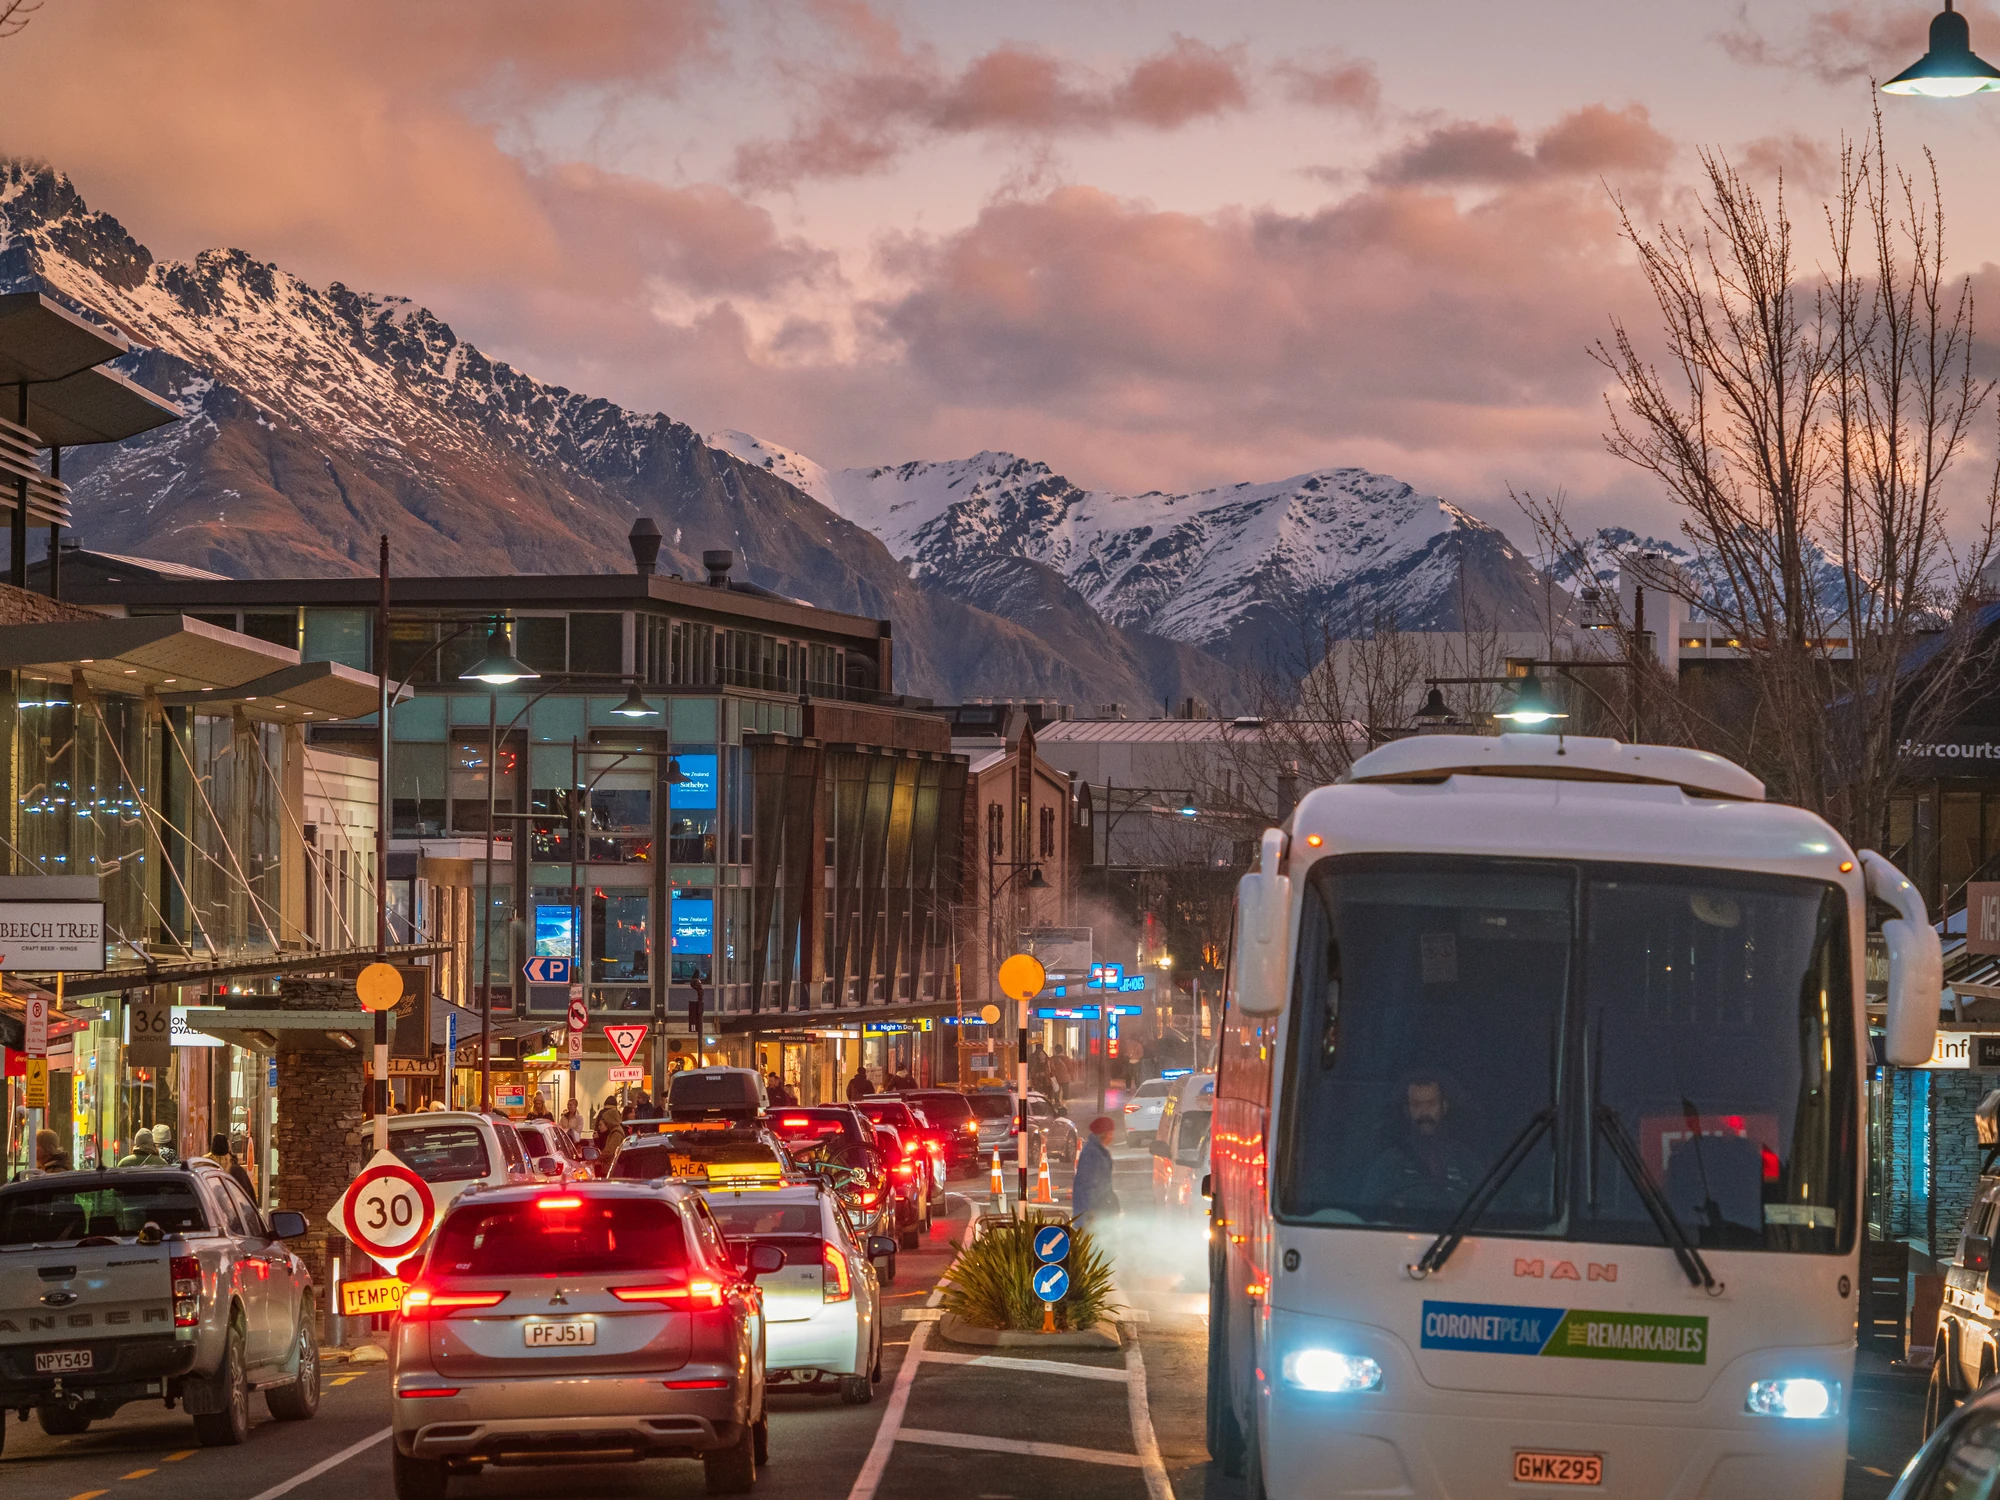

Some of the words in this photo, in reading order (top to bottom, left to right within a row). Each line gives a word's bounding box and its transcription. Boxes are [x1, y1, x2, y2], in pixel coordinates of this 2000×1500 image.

[0, 922, 53, 938] BEECH
[57, 923, 99, 938] TREE
[549, 961, 564, 979] P
[135, 1010, 166, 1032] 36
[1938, 1039, 1970, 1058] inf
[367, 1194, 412, 1229] 30
[1514, 1259, 1618, 1282] MAN
[533, 1326, 585, 1342] PFJ51
[1587, 1323, 1703, 1352] REMARKABLES
[37, 1352, 91, 1370] NPY549
[1518, 1457, 1598, 1480] GWK295
